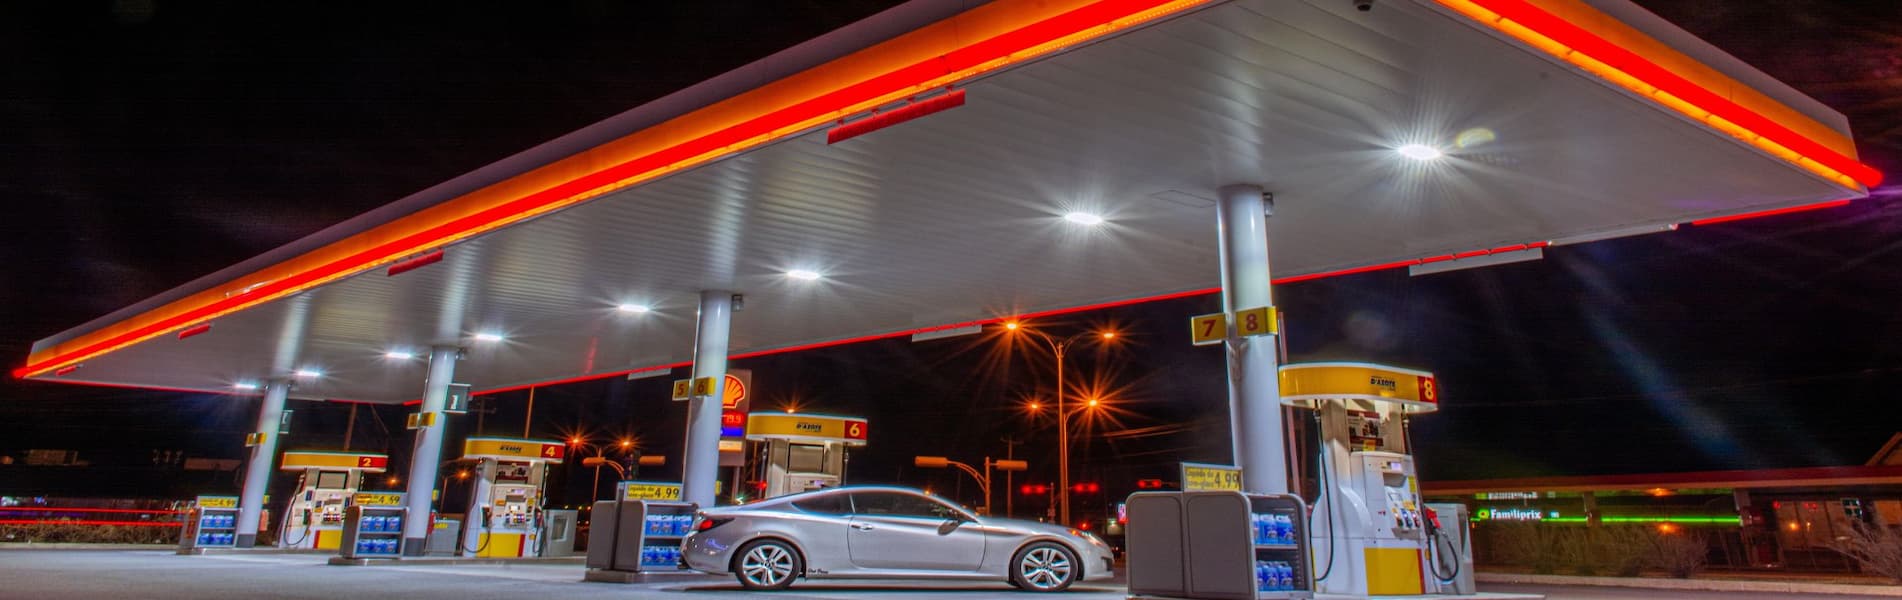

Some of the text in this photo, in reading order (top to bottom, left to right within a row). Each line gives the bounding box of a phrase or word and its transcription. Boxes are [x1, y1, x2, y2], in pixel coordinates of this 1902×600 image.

[1202, 319, 1217, 337] 7
[1246, 313, 1259, 331] 8
[677, 384, 685, 396] 5
[697, 381, 706, 393] 6
[1423, 380, 1434, 400] 8
[849, 423, 861, 437] 6
[545, 446, 556, 457] 4
[362, 458, 372, 467] 2
[1214, 471, 1240, 489] 4.99
[654, 487, 680, 499] 4.99
[1490, 508, 1542, 521] Familiprix
